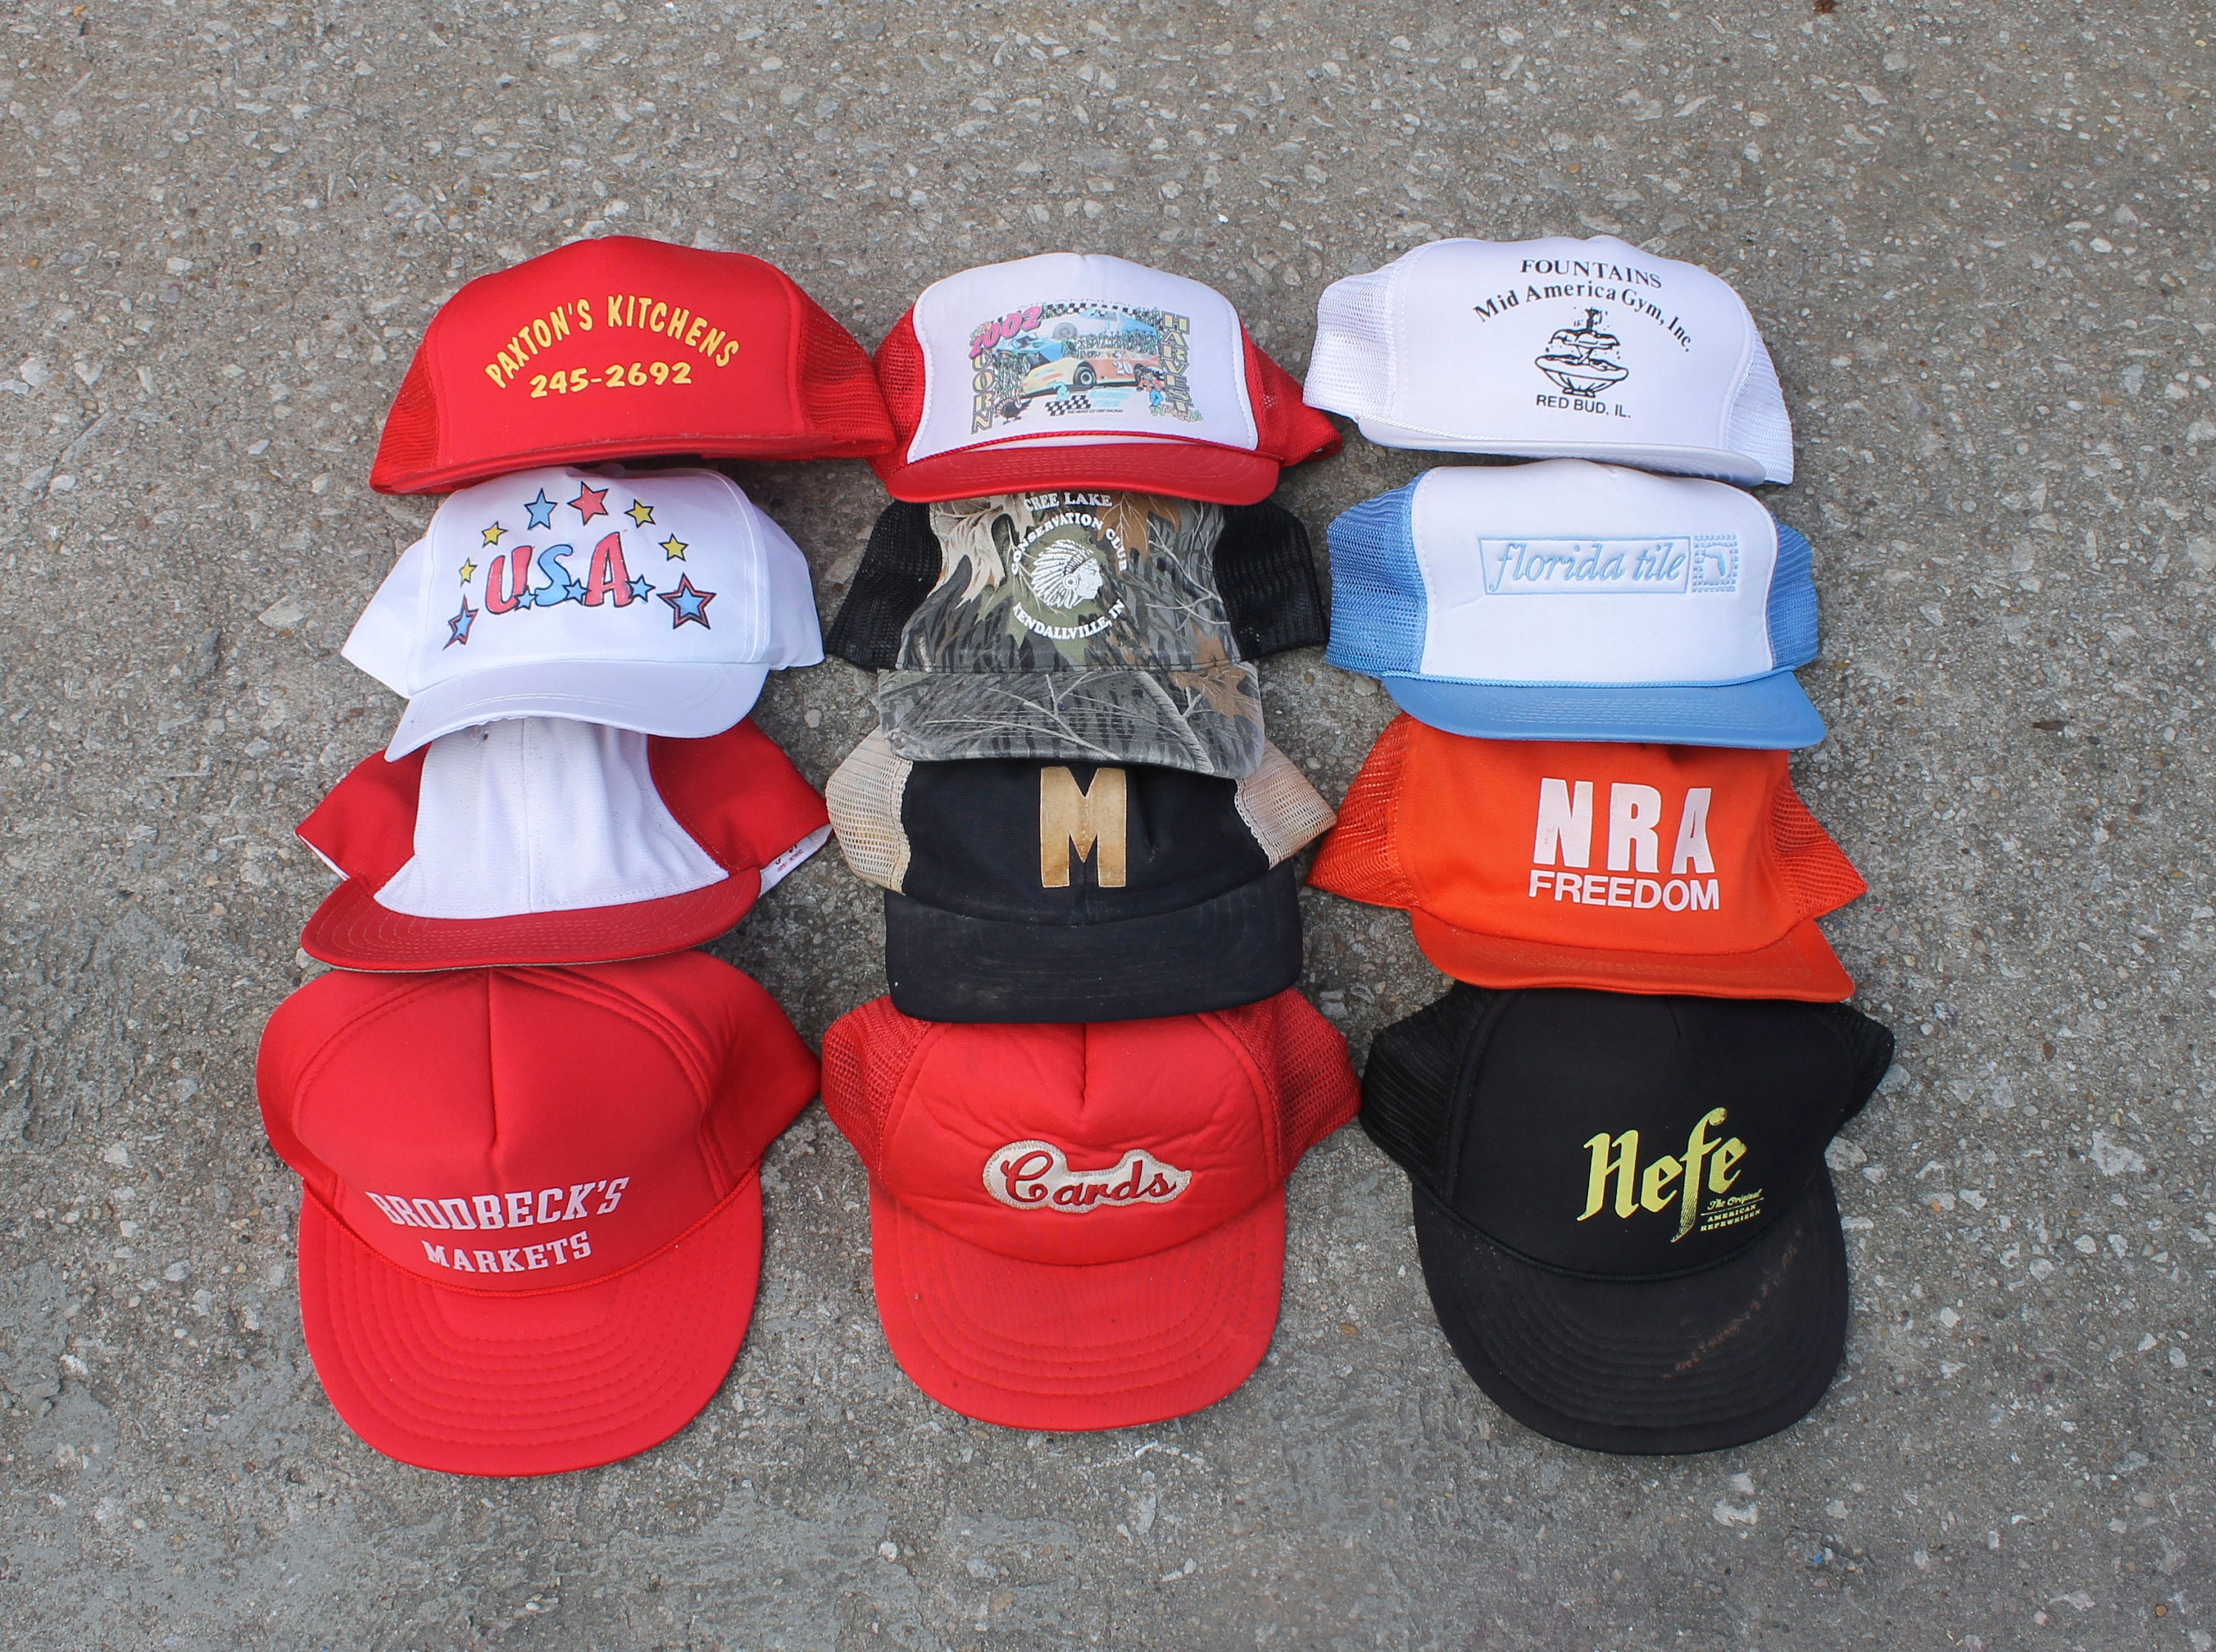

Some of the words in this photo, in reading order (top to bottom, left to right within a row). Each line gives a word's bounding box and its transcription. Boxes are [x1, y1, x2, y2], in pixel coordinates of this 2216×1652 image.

[1519, 258, 1662, 289] FOUNTAINS
[485, 298, 592, 388] PAXTON'S
[607, 294, 739, 367] KITCHENS
[968, 306, 1042, 359] 2002
[1473, 290, 1519, 323] Mid
[1525, 281, 1616, 303] America
[1621, 289, 1664, 326] Gym,
[1667, 315, 1692, 352] Inc.
[530, 361, 692, 398] 245-2692
[1161, 311, 1194, 412] HARVEST
[1536, 394, 1569, 409] RED
[1615, 404, 1631, 419] IL.
[1024, 493, 1059, 512] CREE
[1064, 492, 1112, 507] LAKE
[1011, 513, 1104, 575] CONSERVATION
[1105, 528, 1127, 572] CLUB
[1488, 543, 1627, 592] florida
[1632, 543, 1686, 580] tile
[1013, 602, 1112, 640] KENDALLVILLE,
[1109, 599, 1125, 620] IN
[1040, 766, 1127, 888] M
[1533, 778, 1715, 874] NRA
[1529, 869, 1720, 911] FREEDOM
[1001, 1151, 1177, 1206] Cards
[1576, 1107, 1748, 1243] Hefe
[1707, 1198, 1726, 1210] The
[1727, 1188, 1762, 1205] Original
[365, 1176, 630, 1230] BRODBECK'S
[1707, 1204, 1757, 1222] AMERICAN
[422, 1230, 591, 1272] MARKETS
